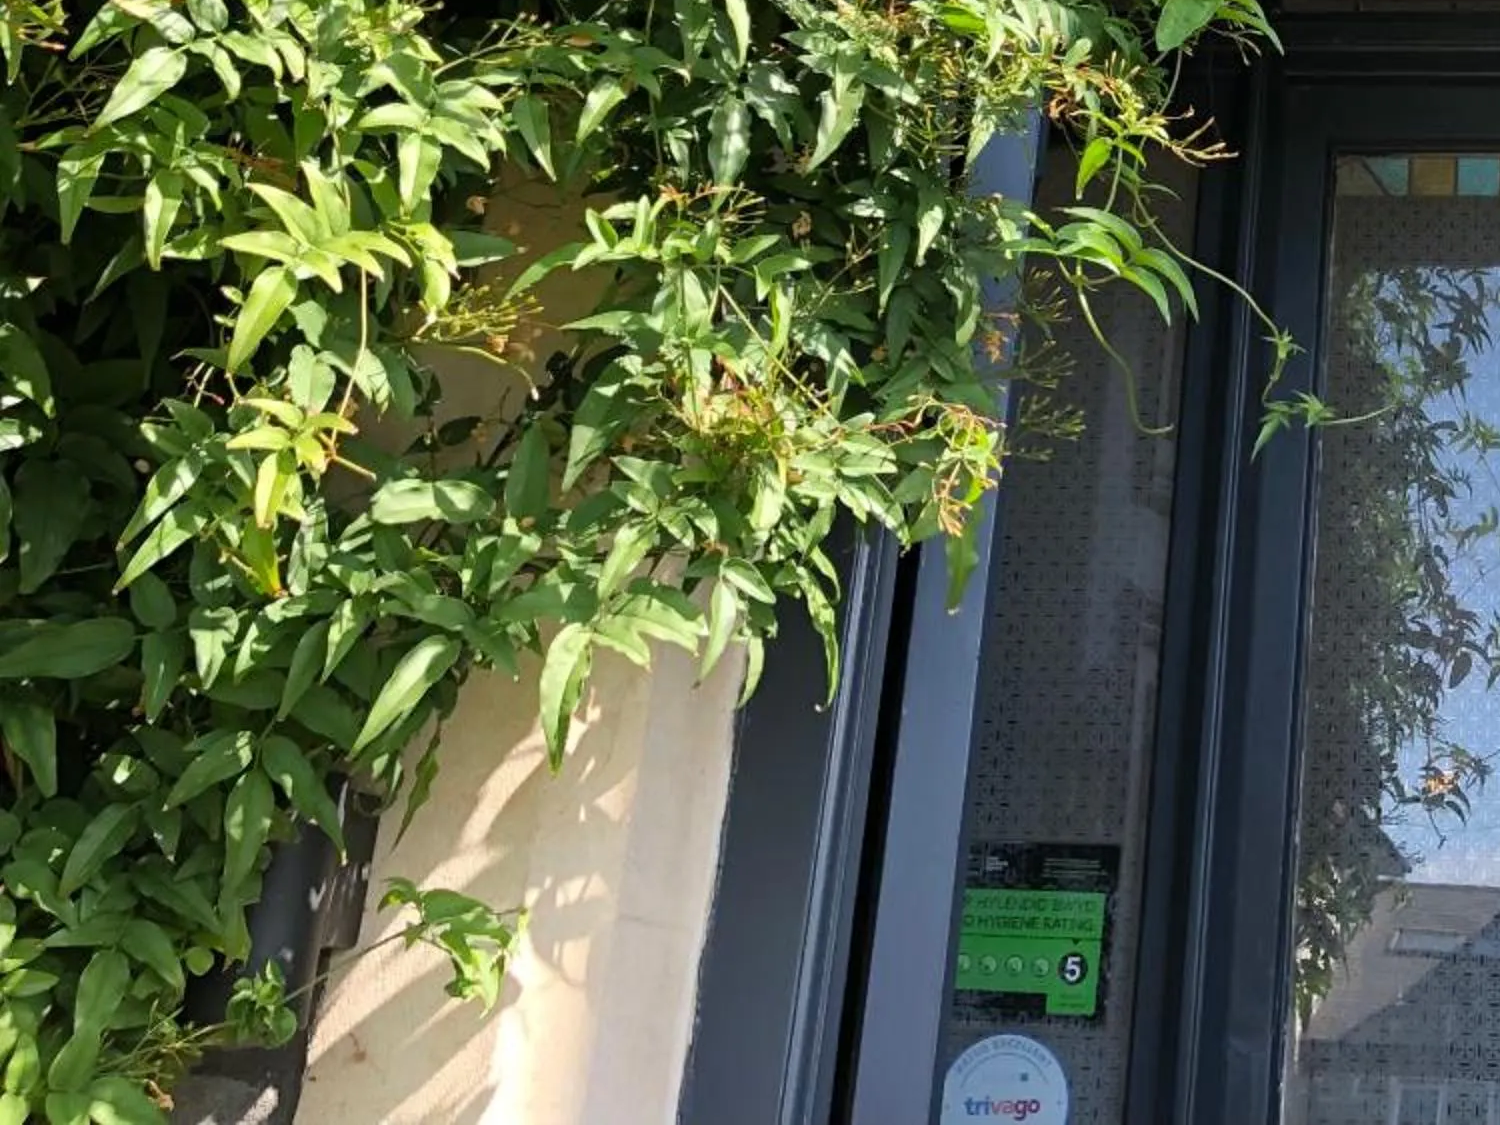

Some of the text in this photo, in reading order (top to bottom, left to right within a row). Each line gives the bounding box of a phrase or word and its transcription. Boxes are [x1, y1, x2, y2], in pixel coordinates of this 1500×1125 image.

[977, 914, 1042, 930] HYGIENE
[1043, 917, 1094, 932] RATING
[1064, 956, 1082, 982] 5
[964, 1096, 1041, 1121] trivago
